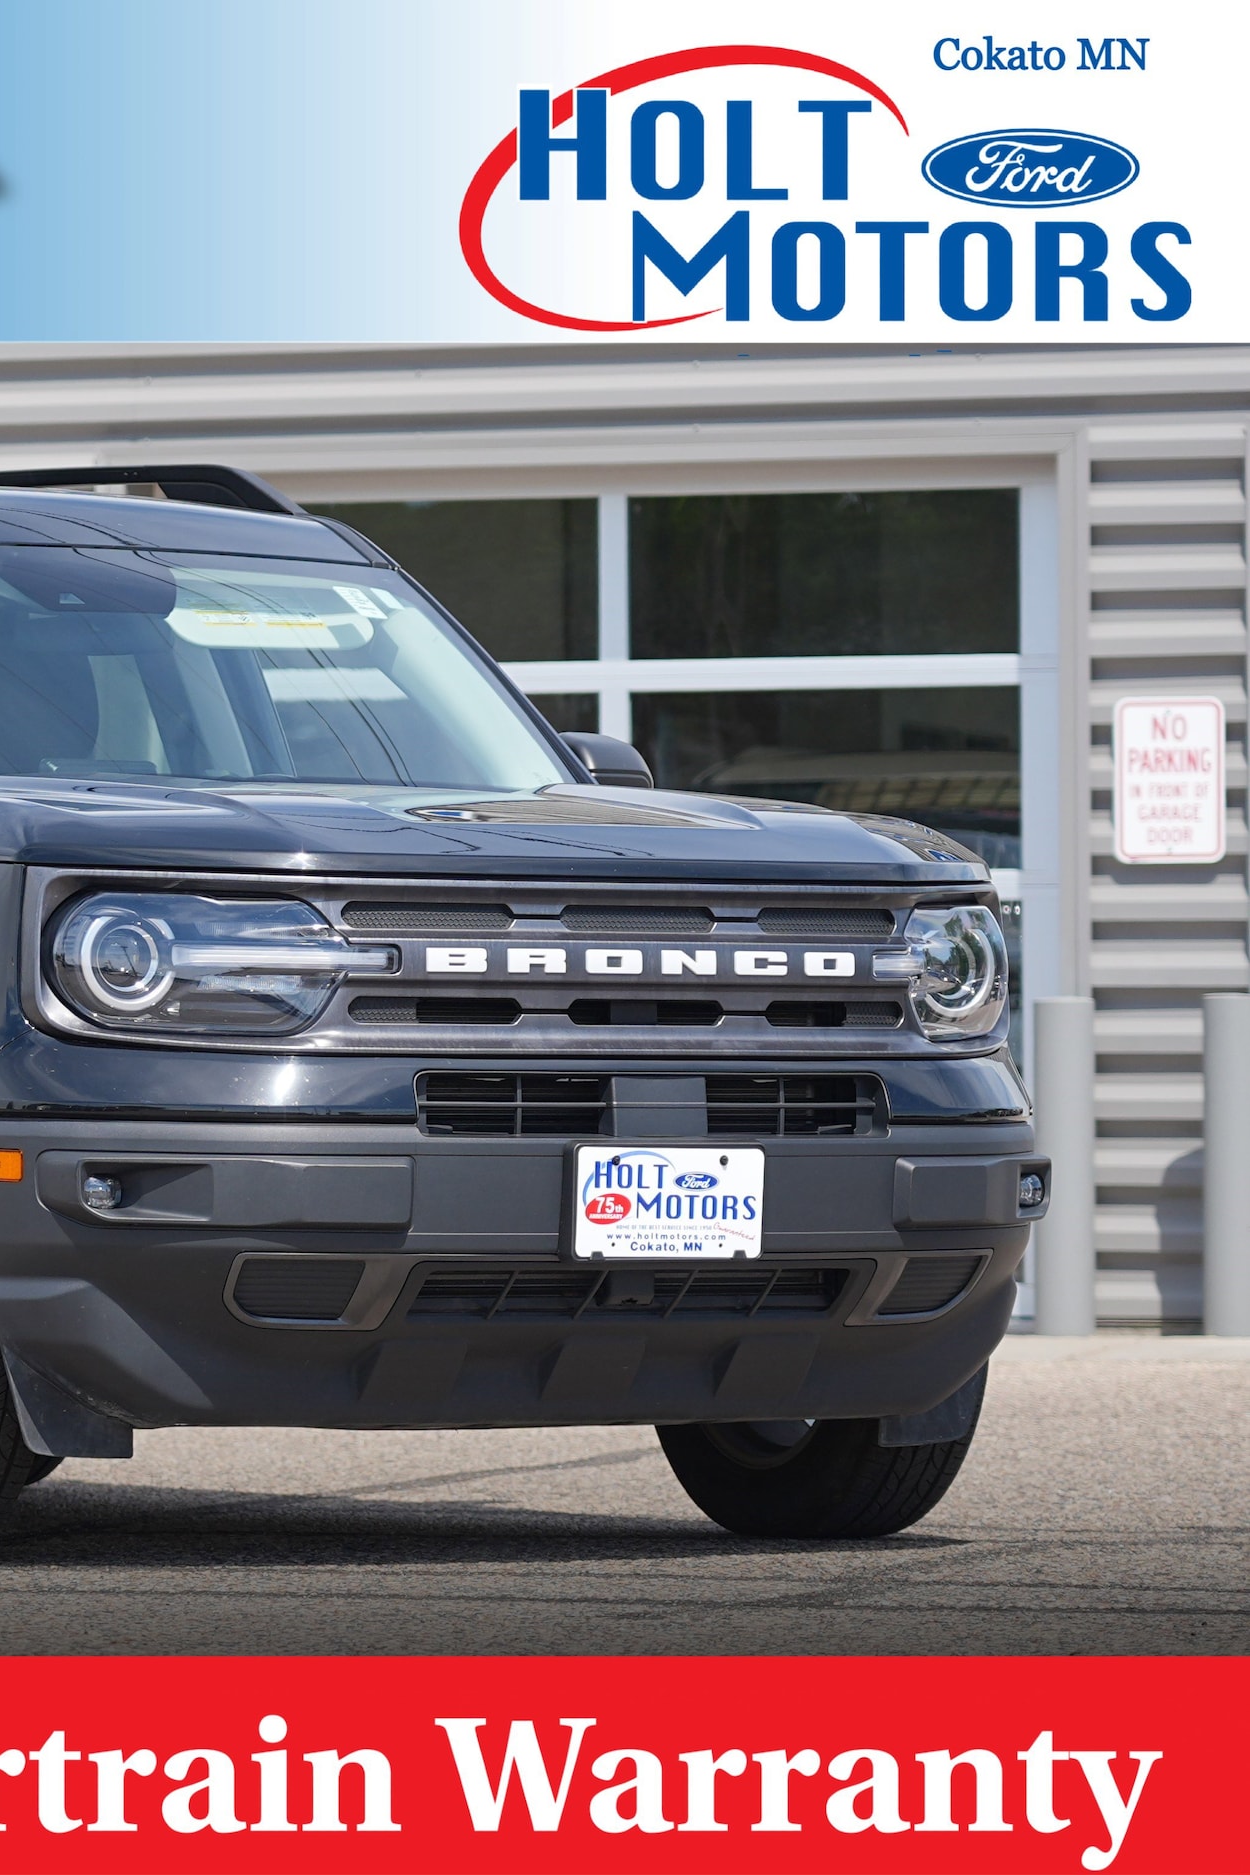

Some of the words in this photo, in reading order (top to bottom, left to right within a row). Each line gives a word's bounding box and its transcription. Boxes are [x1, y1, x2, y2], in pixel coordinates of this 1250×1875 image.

[1152, 714, 1187, 741] NO
[1128, 748, 1212, 773] PARKING
[1131, 784, 1142, 798] IN
[1150, 783, 1188, 798] FRONT
[1196, 783, 1210, 797] OF
[1138, 804, 1202, 821] GARAGE
[1147, 826, 1193, 844] DOOR
[425, 947, 856, 977] BRONCO
[594, 1161, 669, 1189] HOLT
[681, 1174, 712, 1190] Ford
[595, 1197, 624, 1214] 75th
[636, 1192, 757, 1220] MOTORS
[607, 1232, 726, 1241] www.holtmotors.com
[630, 1241, 679, 1254] Cokato,
[684, 1242, 703, 1252] MN
